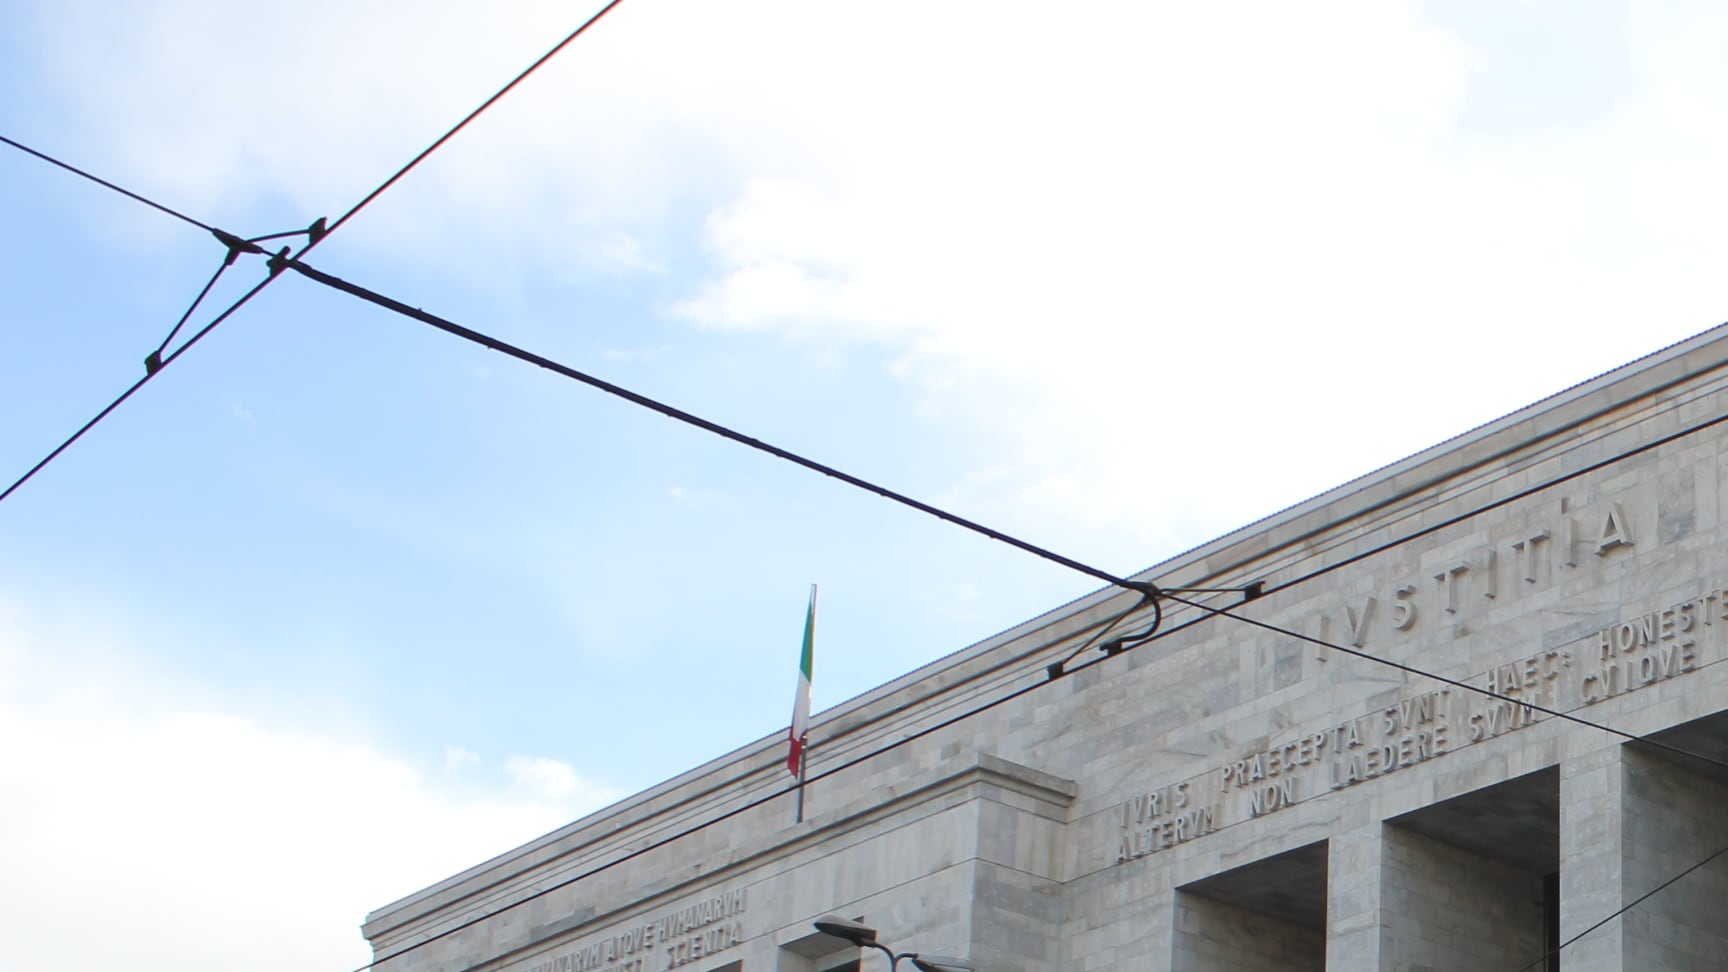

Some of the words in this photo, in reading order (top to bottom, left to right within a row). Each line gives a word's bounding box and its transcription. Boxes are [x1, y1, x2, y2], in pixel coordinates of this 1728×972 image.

[1317, 500, 1635, 663] IVSTITIA
[1116, 802, 1219, 864] ALTERVM
[1249, 774, 1299, 819] NON
[1329, 722, 1450, 791] LAEDERE
[1469, 692, 1544, 743] SVVM
[1580, 638, 1697, 705] CVIQVE
[1120, 780, 1190, 830] IVRIS
[1220, 716, 1364, 794] PRAECEPTA
[1384, 686, 1452, 737] SVNT
[606, 924, 656, 963] ATQVE
[665, 920, 747, 971] SCIENTIA
